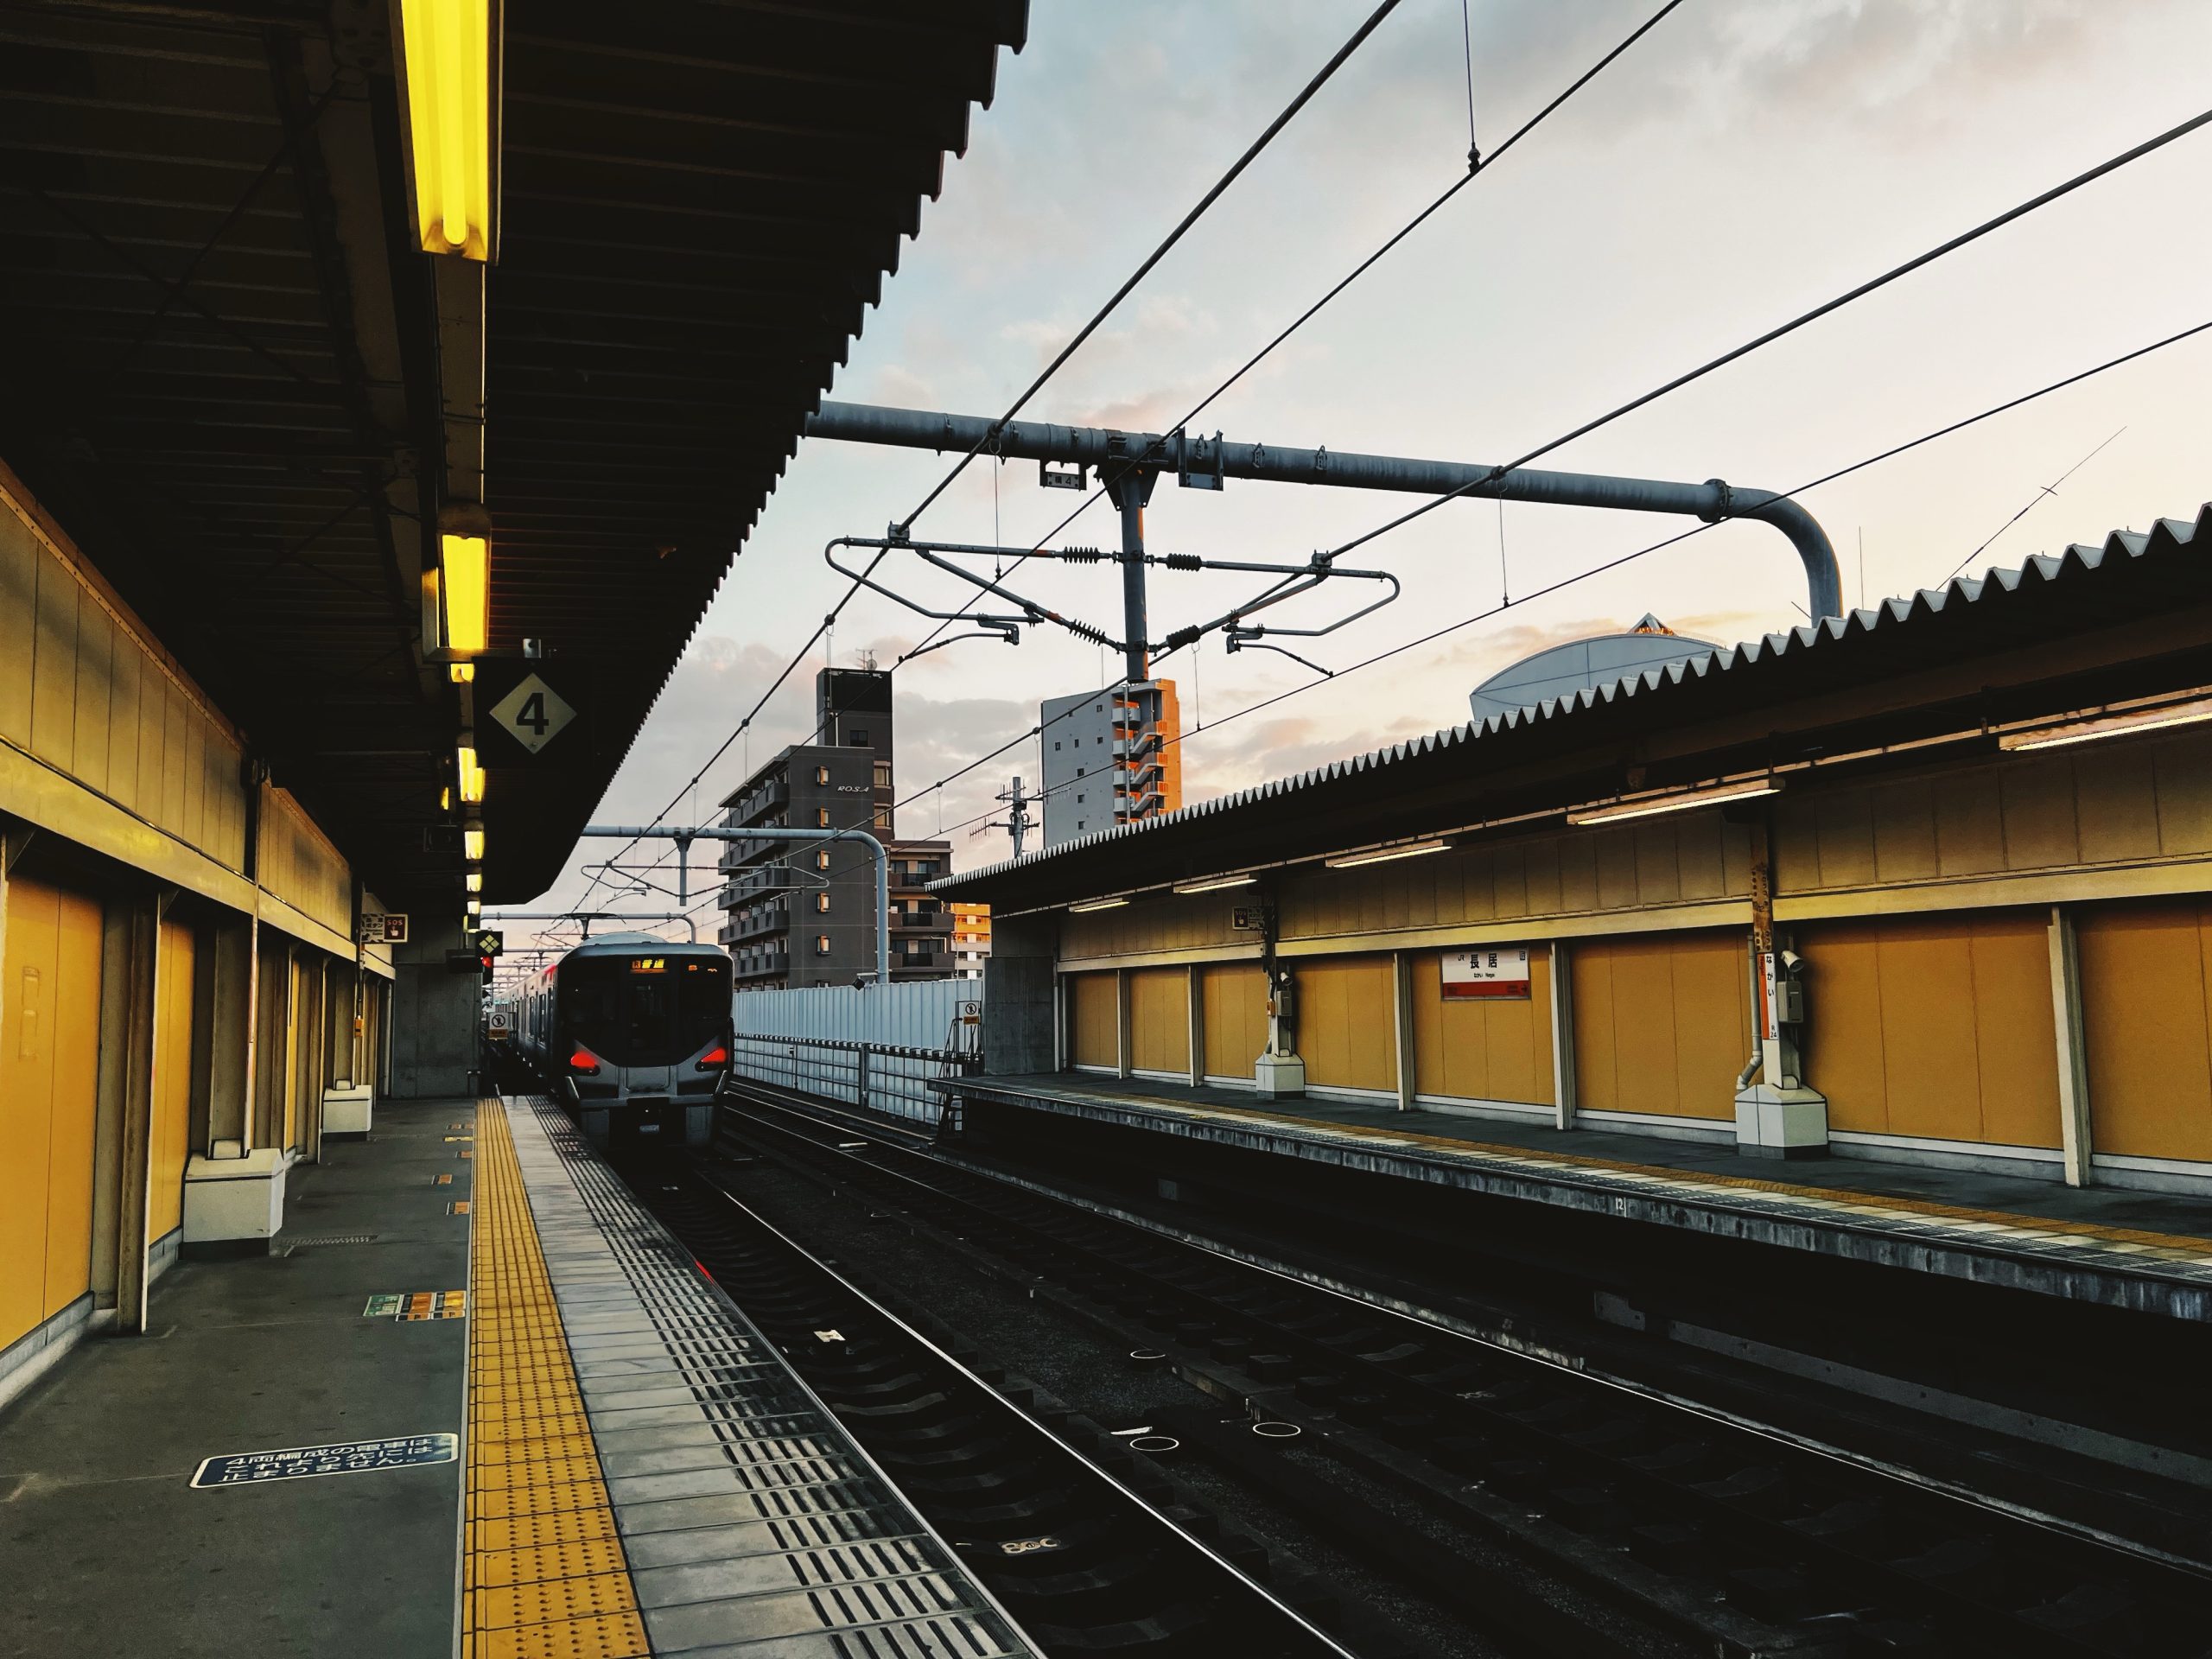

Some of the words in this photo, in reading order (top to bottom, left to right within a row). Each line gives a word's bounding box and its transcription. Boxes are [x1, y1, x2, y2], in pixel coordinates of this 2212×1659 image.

[516, 692, 550, 735] 4
[1470, 952, 1497, 969] 長居
[1766, 956, 1775, 996] ながい
[1615, 1197, 1624, 1211] 12
[224, 1446, 435, 1474] これより先には
[226, 1437, 434, 1465] 4両編成の電車は
[217, 1457, 418, 1483] 止まりません。
